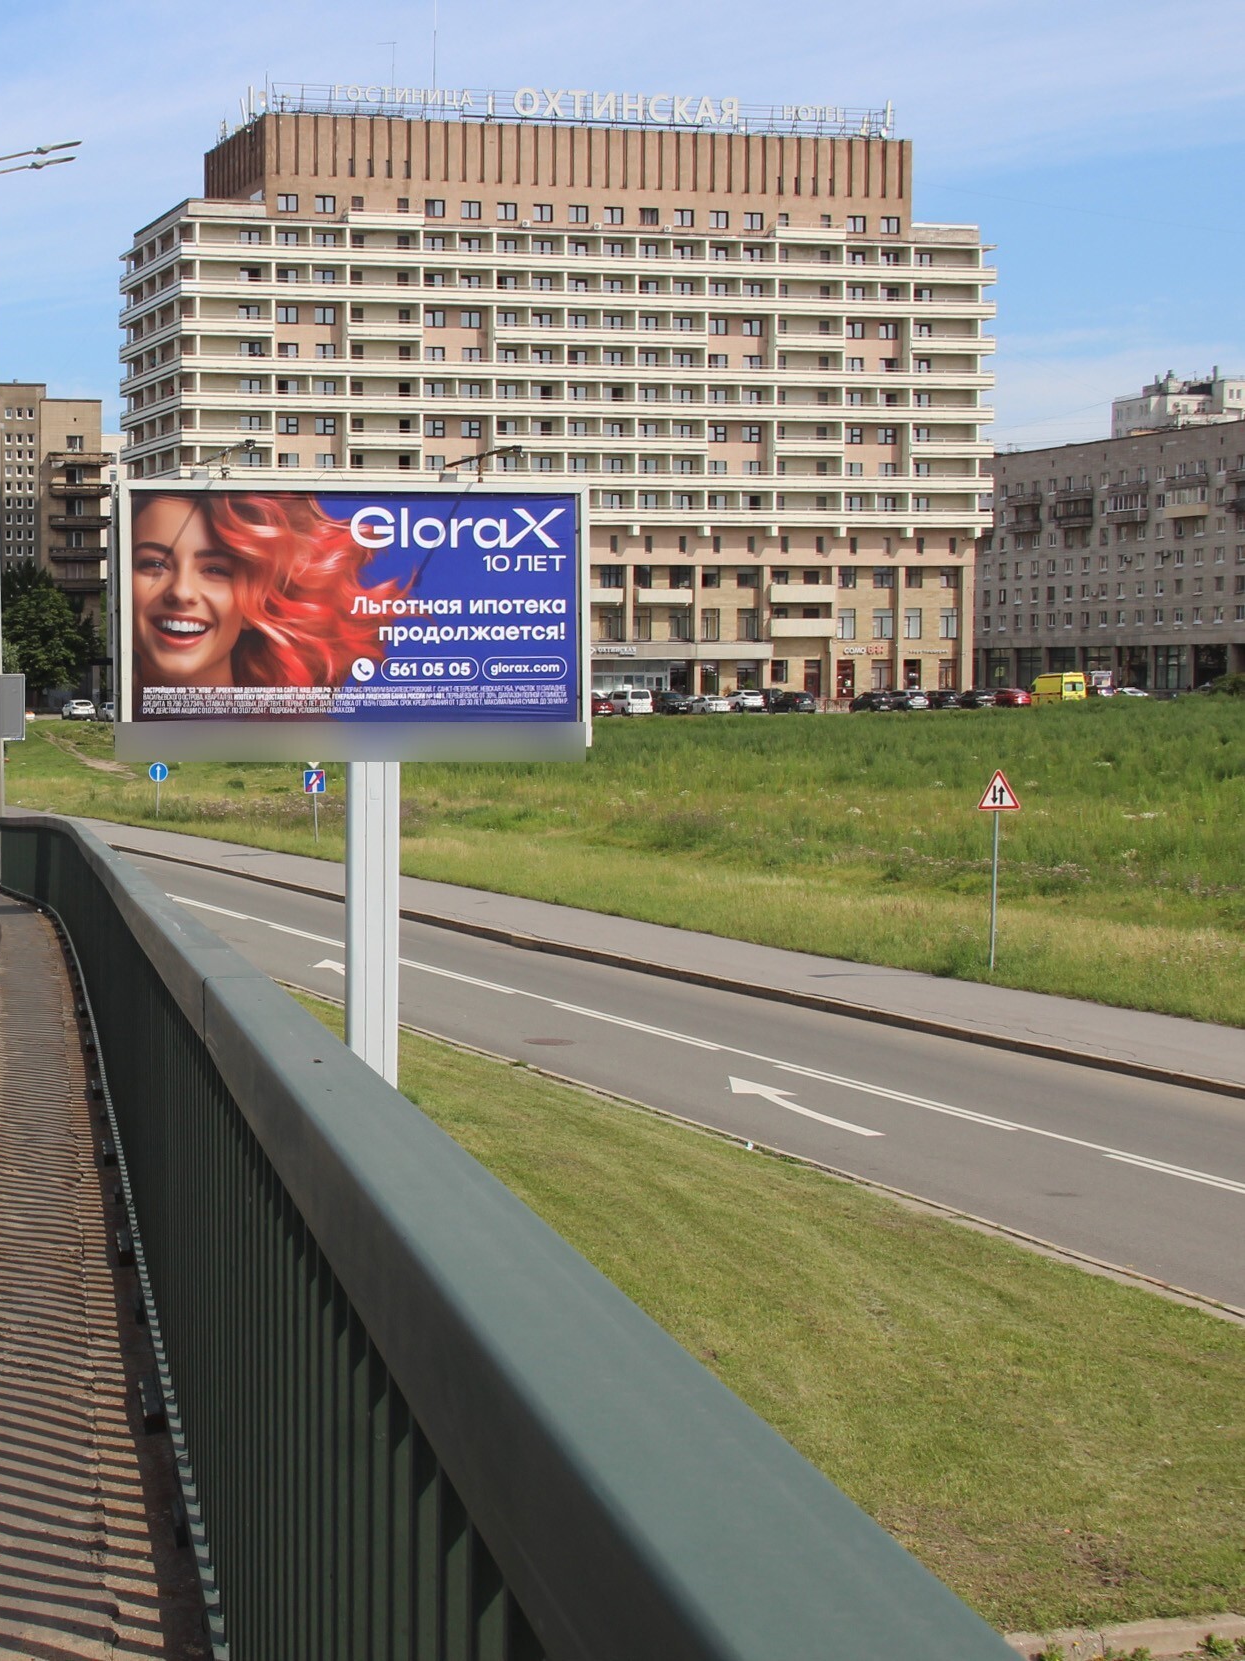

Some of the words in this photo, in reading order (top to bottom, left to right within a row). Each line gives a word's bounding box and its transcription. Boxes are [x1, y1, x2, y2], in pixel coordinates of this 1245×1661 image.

[334, 85, 473, 109] ГОСТИНИЦА
[513, 88, 738, 125] ОХТИНСКАЯ
[782, 105, 845, 122] HOTEL
[350, 506, 566, 549] GloraX
[482, 555, 510, 572] 10
[514, 555, 566, 572] ЛЕТ
[351, 596, 462, 615] Льготная
[469, 599, 566, 615] ипотека
[379, 622, 566, 647] продолжается!
[389, 662, 417, 677] 561
[421, 662, 445, 677] 05
[448, 662, 471, 677] 05
[490, 663, 560, 676] glorax.com
